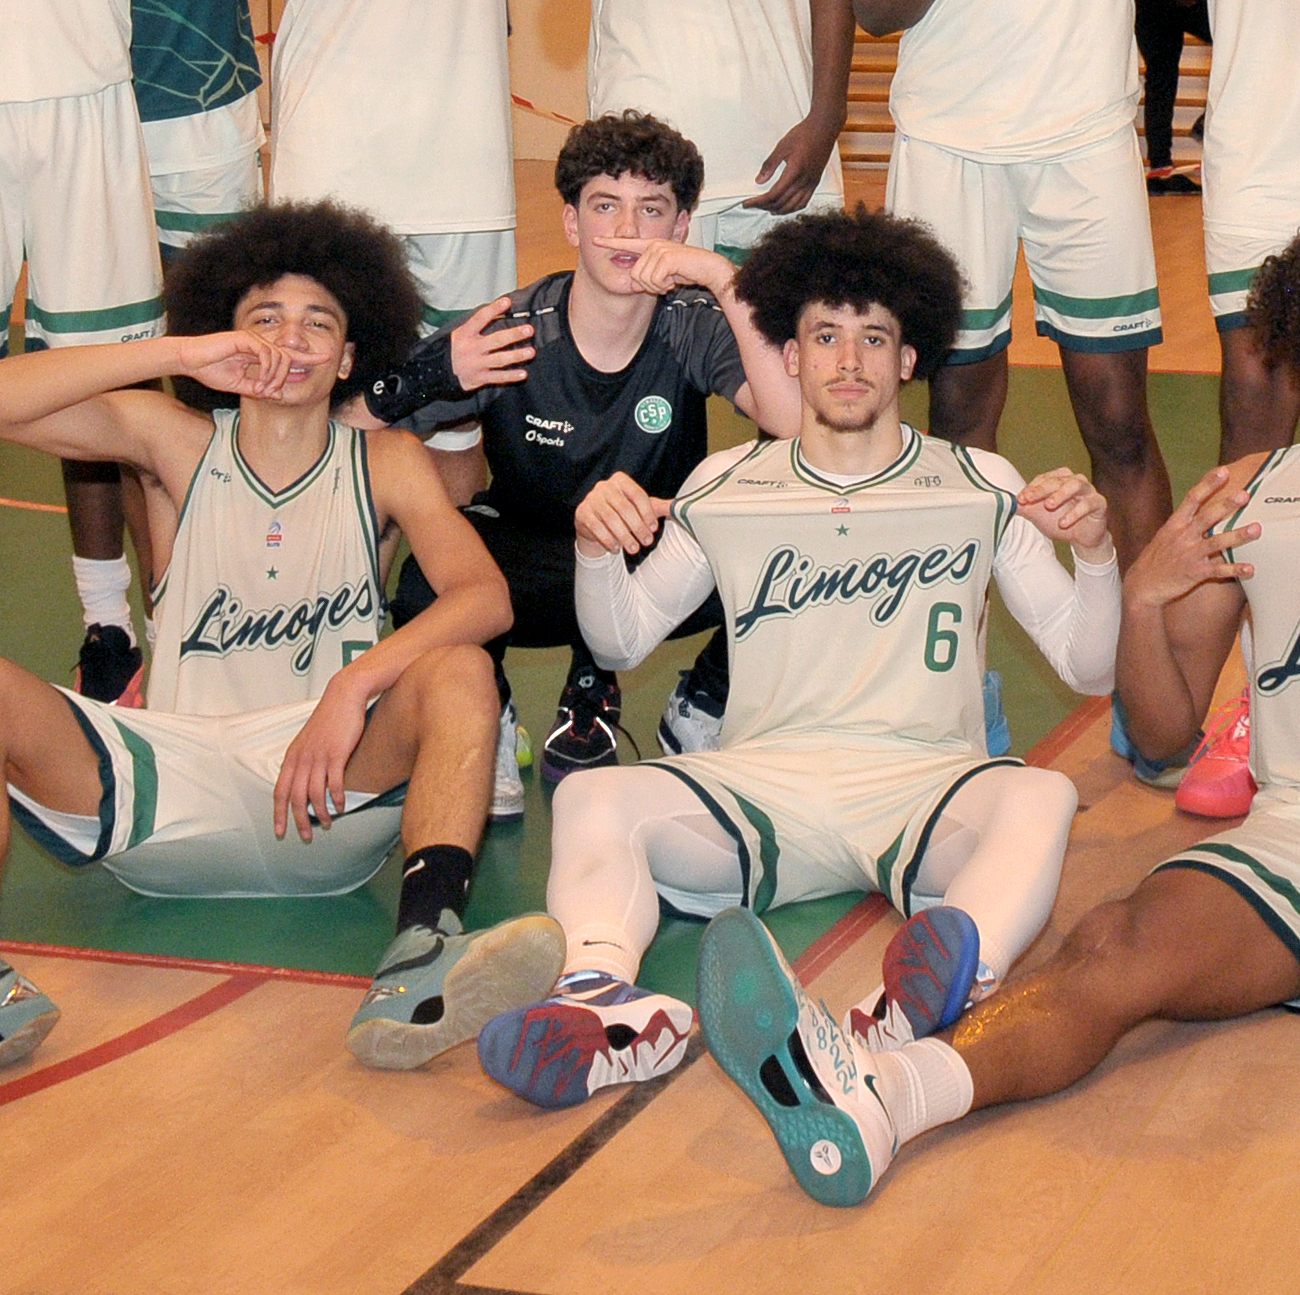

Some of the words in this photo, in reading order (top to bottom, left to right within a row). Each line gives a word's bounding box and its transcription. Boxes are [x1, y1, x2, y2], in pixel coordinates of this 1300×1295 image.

[525, 414, 564, 433] CRAFT
[640, 404, 667, 423] CSP
[181, 577, 373, 672] Limoges
[735, 542, 976, 638] Limoges
[924, 601, 962, 673] 6
